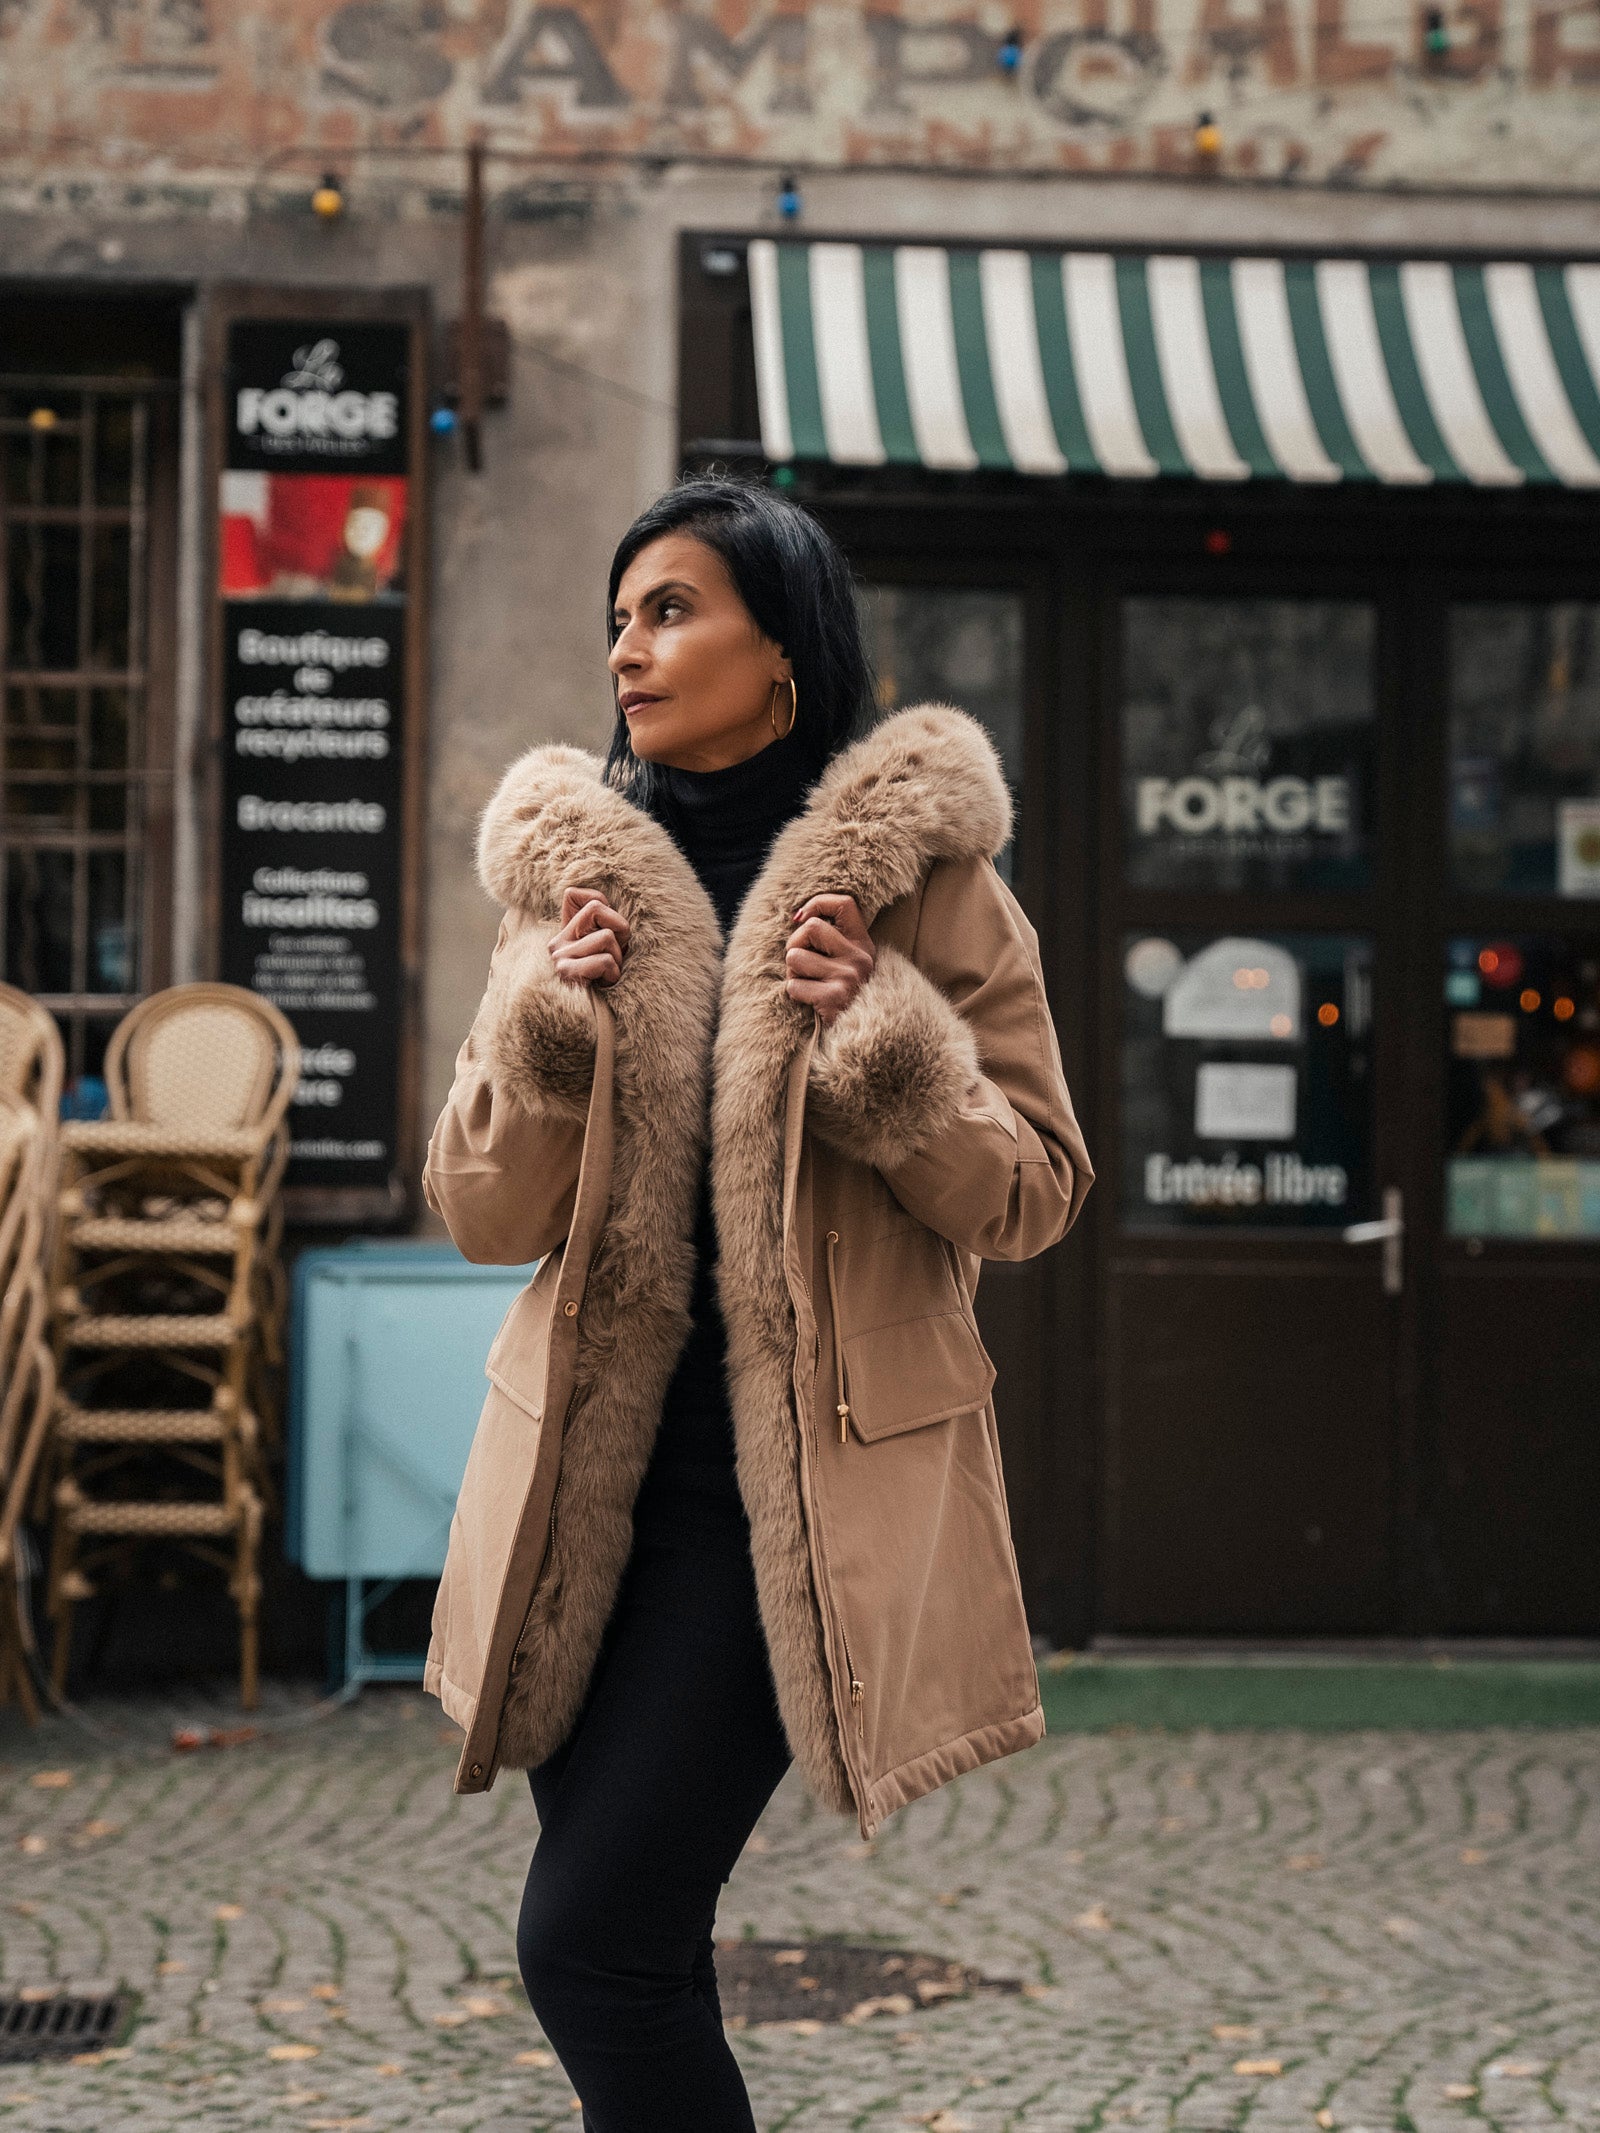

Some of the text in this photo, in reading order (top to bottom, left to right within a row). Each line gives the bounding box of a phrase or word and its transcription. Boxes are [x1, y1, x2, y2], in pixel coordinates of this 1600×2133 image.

[238, 388, 397, 437] FORGE
[239, 630, 388, 671] Boutique
[237, 690, 388, 727] créateurs
[237, 729, 388, 761] recycleurs
[239, 797, 385, 832] Brocante
[1139, 778, 1350, 834] FORGE
[255, 868, 368, 895] Collections
[243, 893, 378, 928] insolites
[1146, 1153, 1347, 1204] Entrée libre
